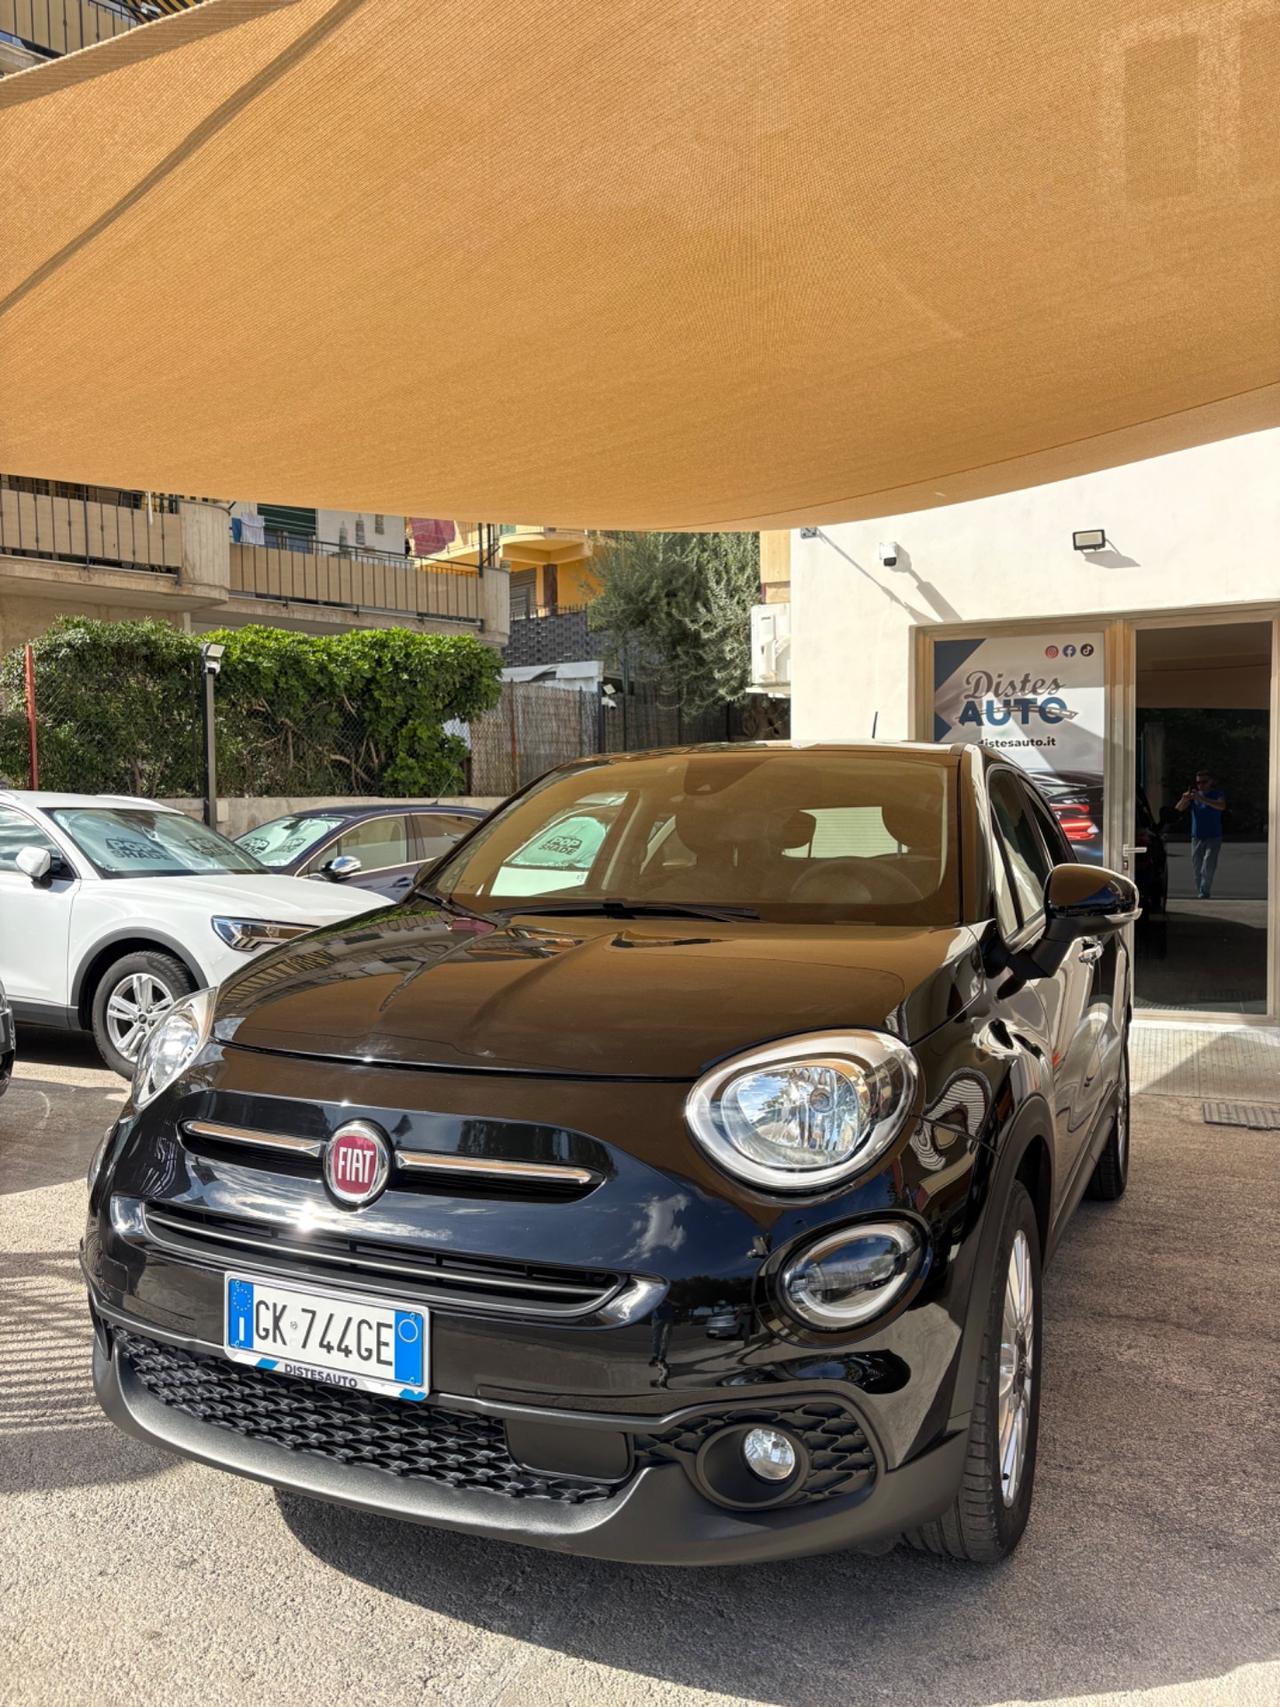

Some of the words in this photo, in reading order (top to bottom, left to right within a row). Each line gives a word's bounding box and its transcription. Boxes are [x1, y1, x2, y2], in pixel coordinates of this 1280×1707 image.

[964, 670, 1066, 699] Distes
[958, 696, 1068, 726] AUTO
[338, 1146, 374, 1183] FIAT
[255, 1299, 288, 1346] GK
[301, 1308, 393, 1366] 744GE
[284, 1363, 358, 1388] DISTESAUTO
